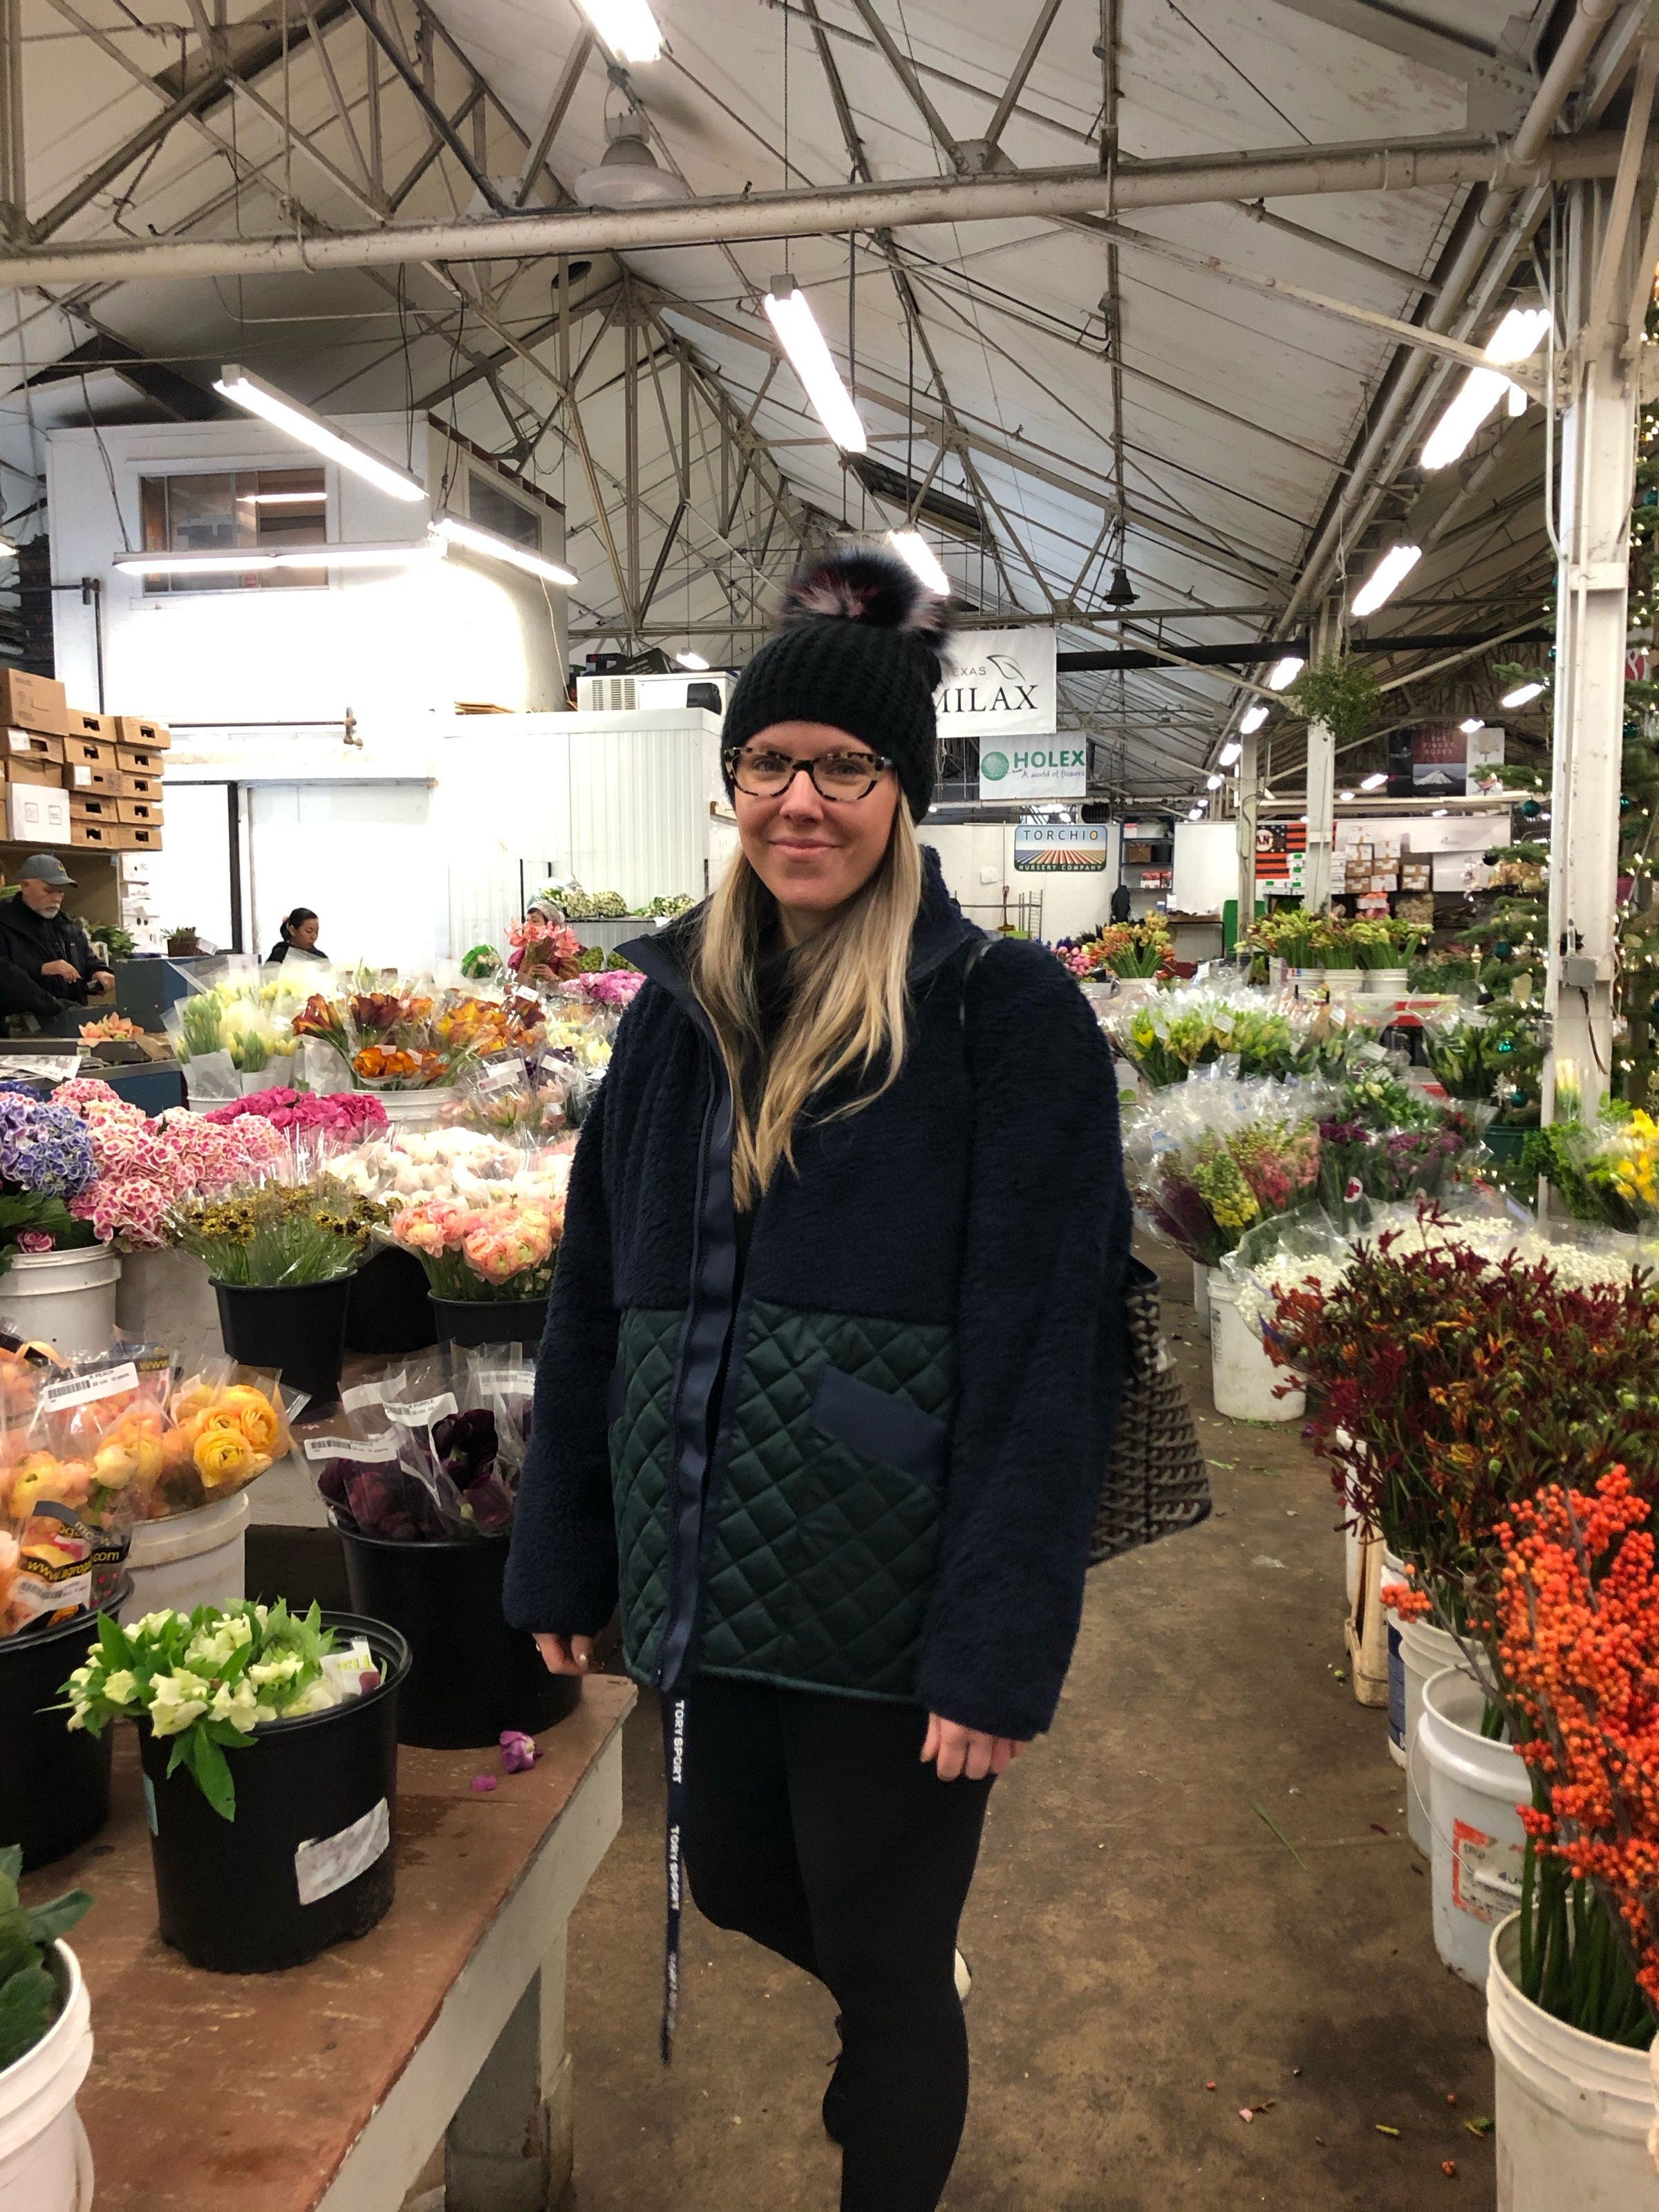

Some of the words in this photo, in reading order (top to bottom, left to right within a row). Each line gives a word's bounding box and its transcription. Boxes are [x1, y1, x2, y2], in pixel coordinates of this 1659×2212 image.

[952, 666, 986, 677] EXAS
[935, 684, 1038, 713] MILAX
[1013, 749, 1085, 769] HOLEX
[1021, 770, 1029, 778] A
[1031, 769, 1050, 778] world
[1051, 769, 1059, 779] of
[1023, 830, 1098, 841] TORCHIO
[675, 1700, 684, 1736] TORY
[672, 1736, 683, 1784] SPORT
[670, 1824, 679, 1861] TORY
